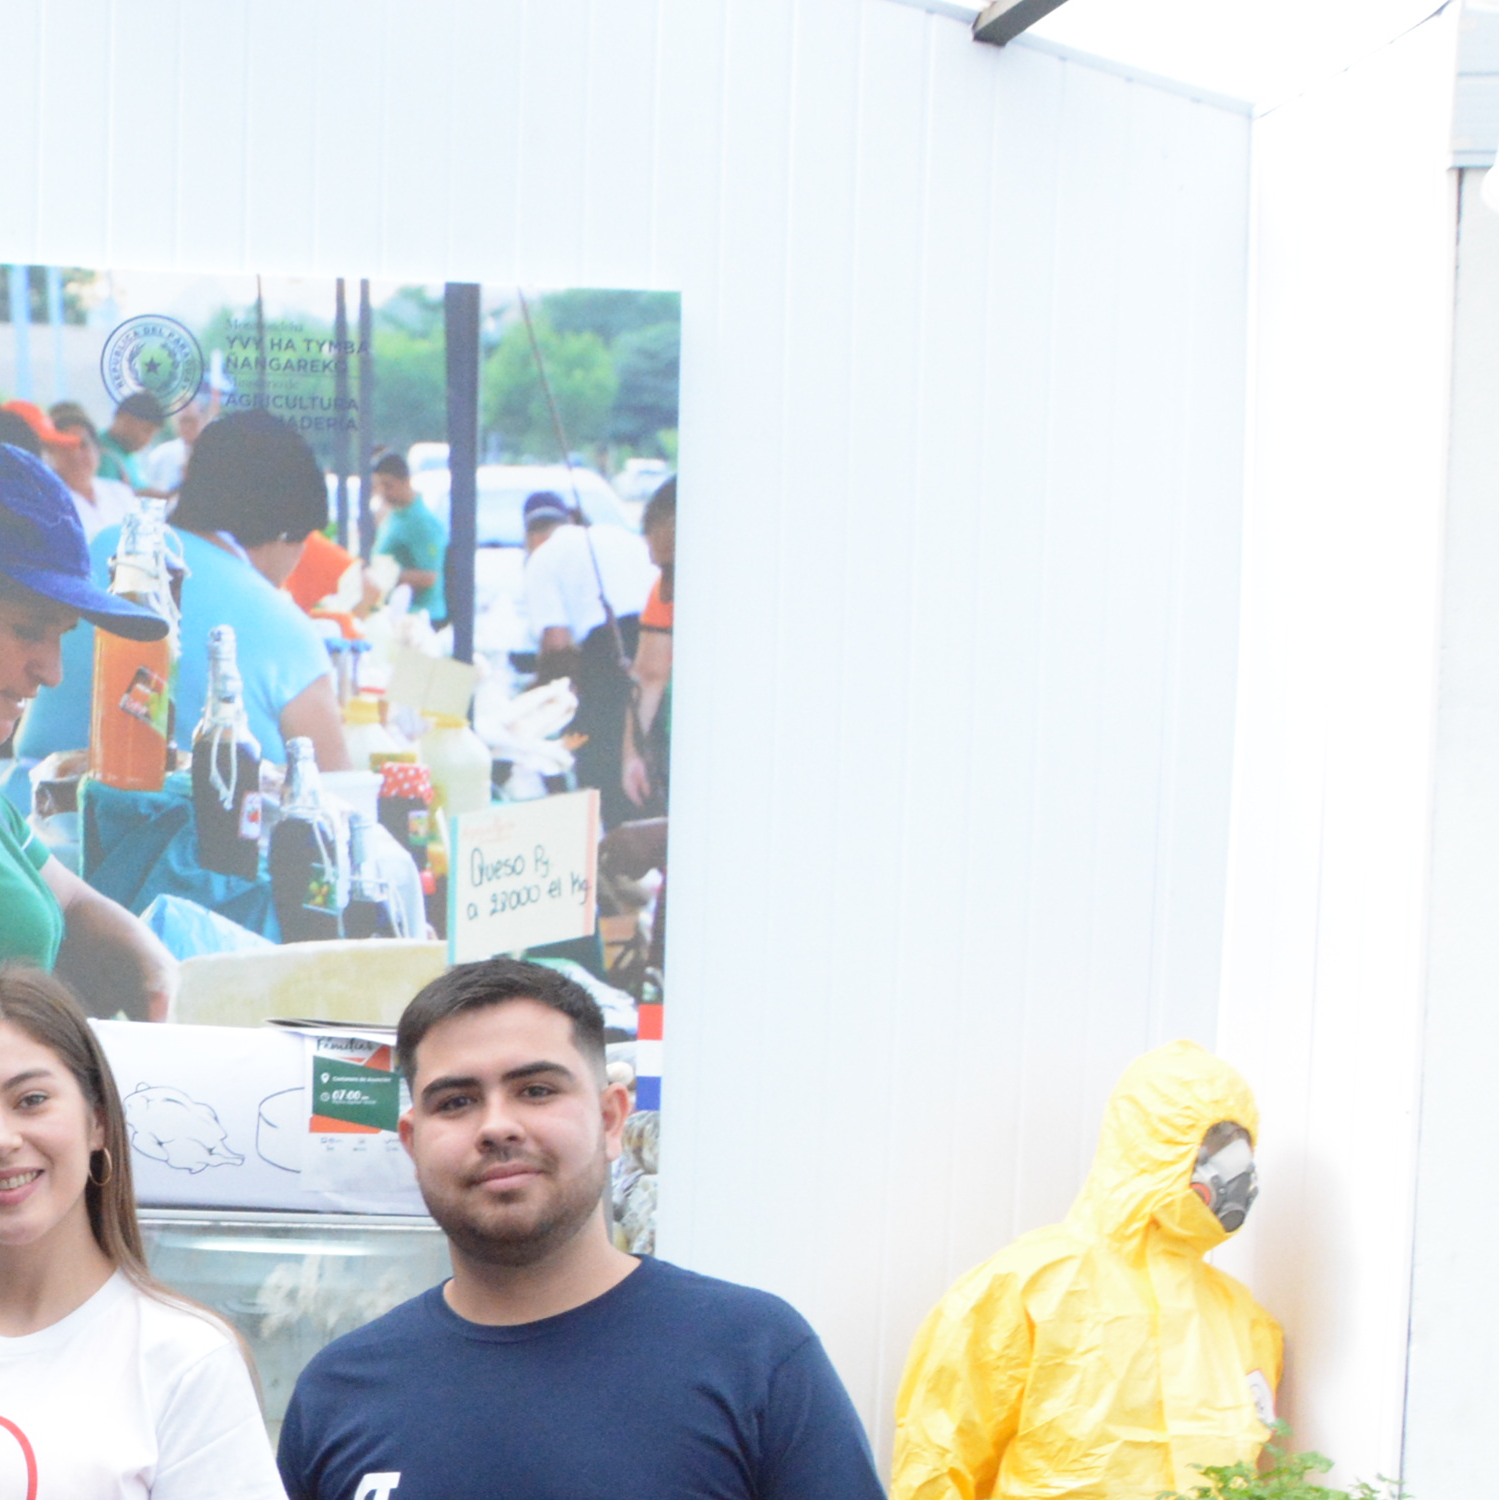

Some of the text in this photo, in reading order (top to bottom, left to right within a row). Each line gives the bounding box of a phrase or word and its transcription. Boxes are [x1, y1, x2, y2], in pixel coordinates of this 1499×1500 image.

[226, 335, 263, 349] YVY
[270, 338, 297, 352] HA
[470, 847, 525, 887] Queso
